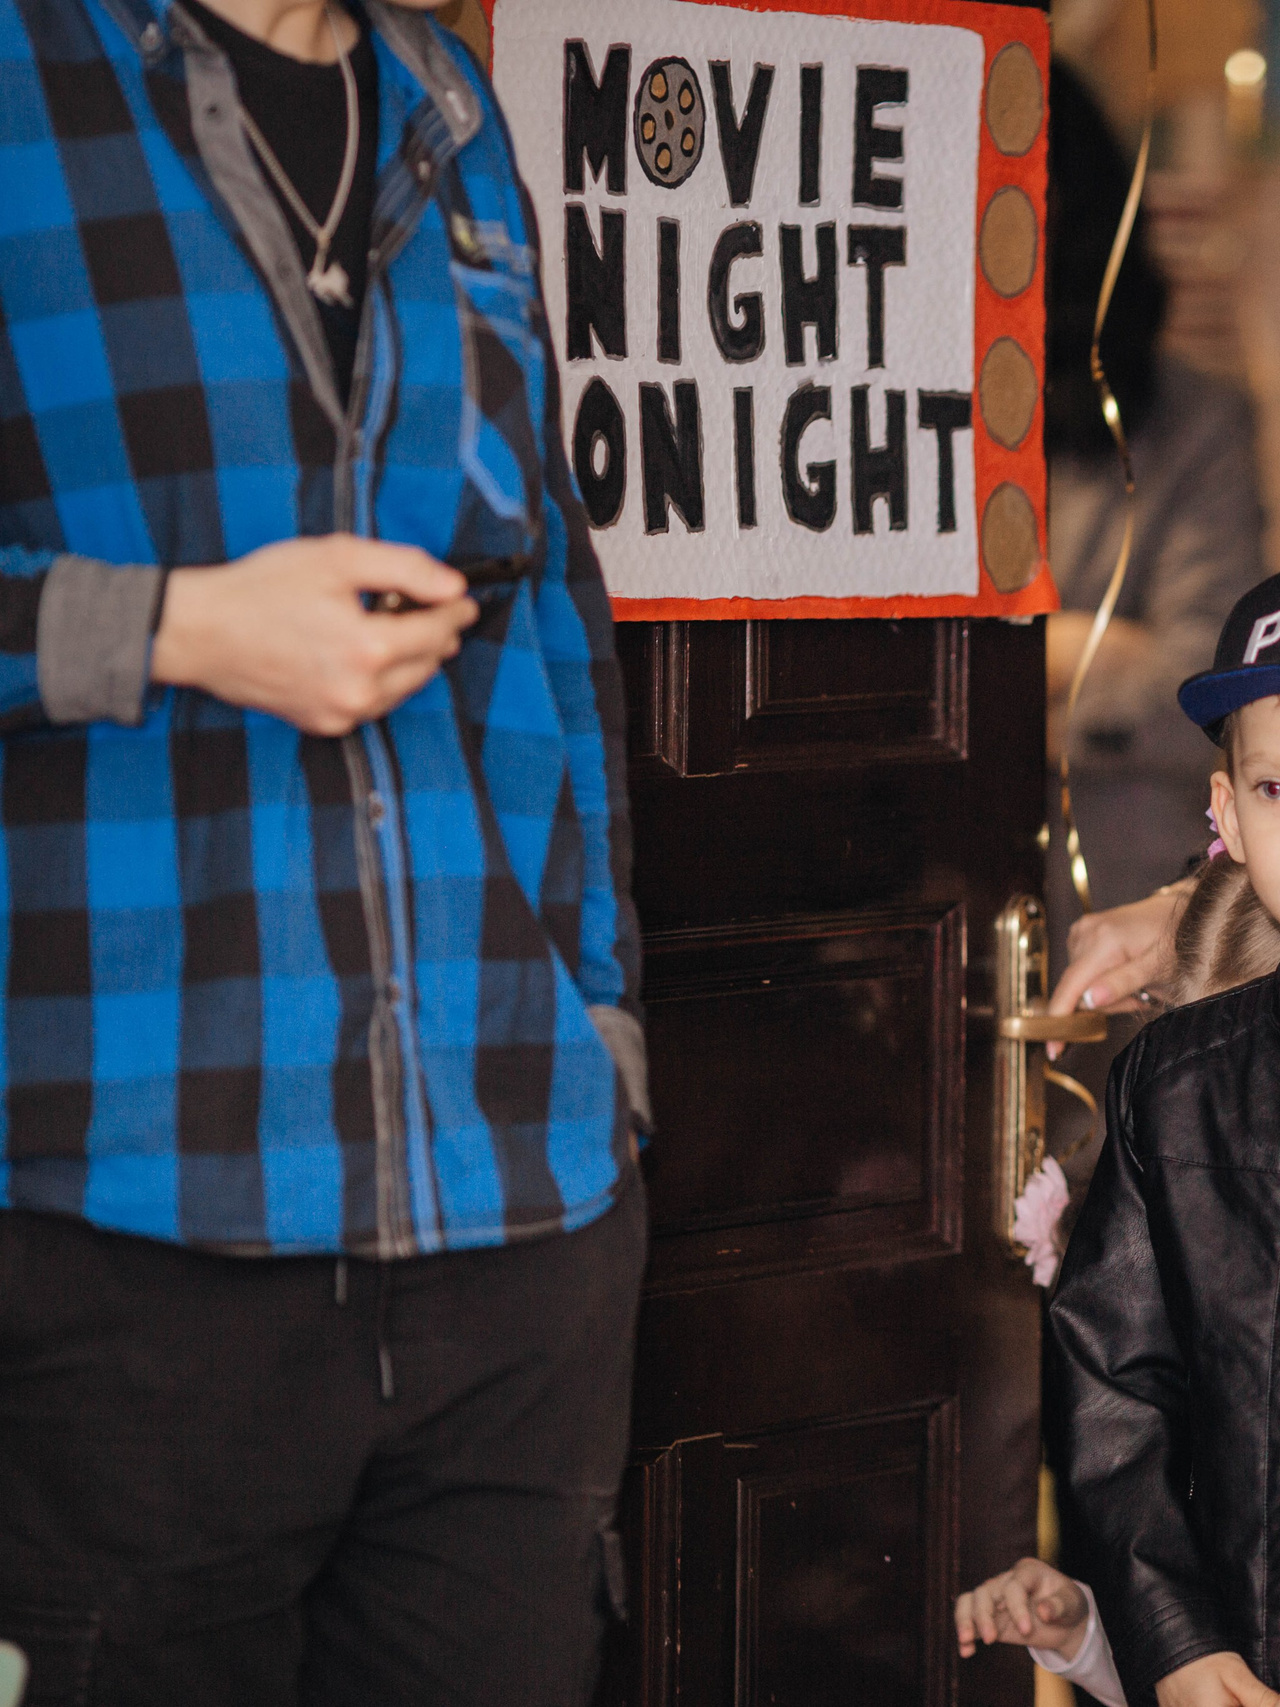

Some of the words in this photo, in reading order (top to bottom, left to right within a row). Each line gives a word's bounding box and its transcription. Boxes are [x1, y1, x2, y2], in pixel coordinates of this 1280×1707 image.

[563, 38, 909, 212] MOVIE
[564, 202, 907, 369] NIGHT
[572, 375, 973, 535] ONIGHT
